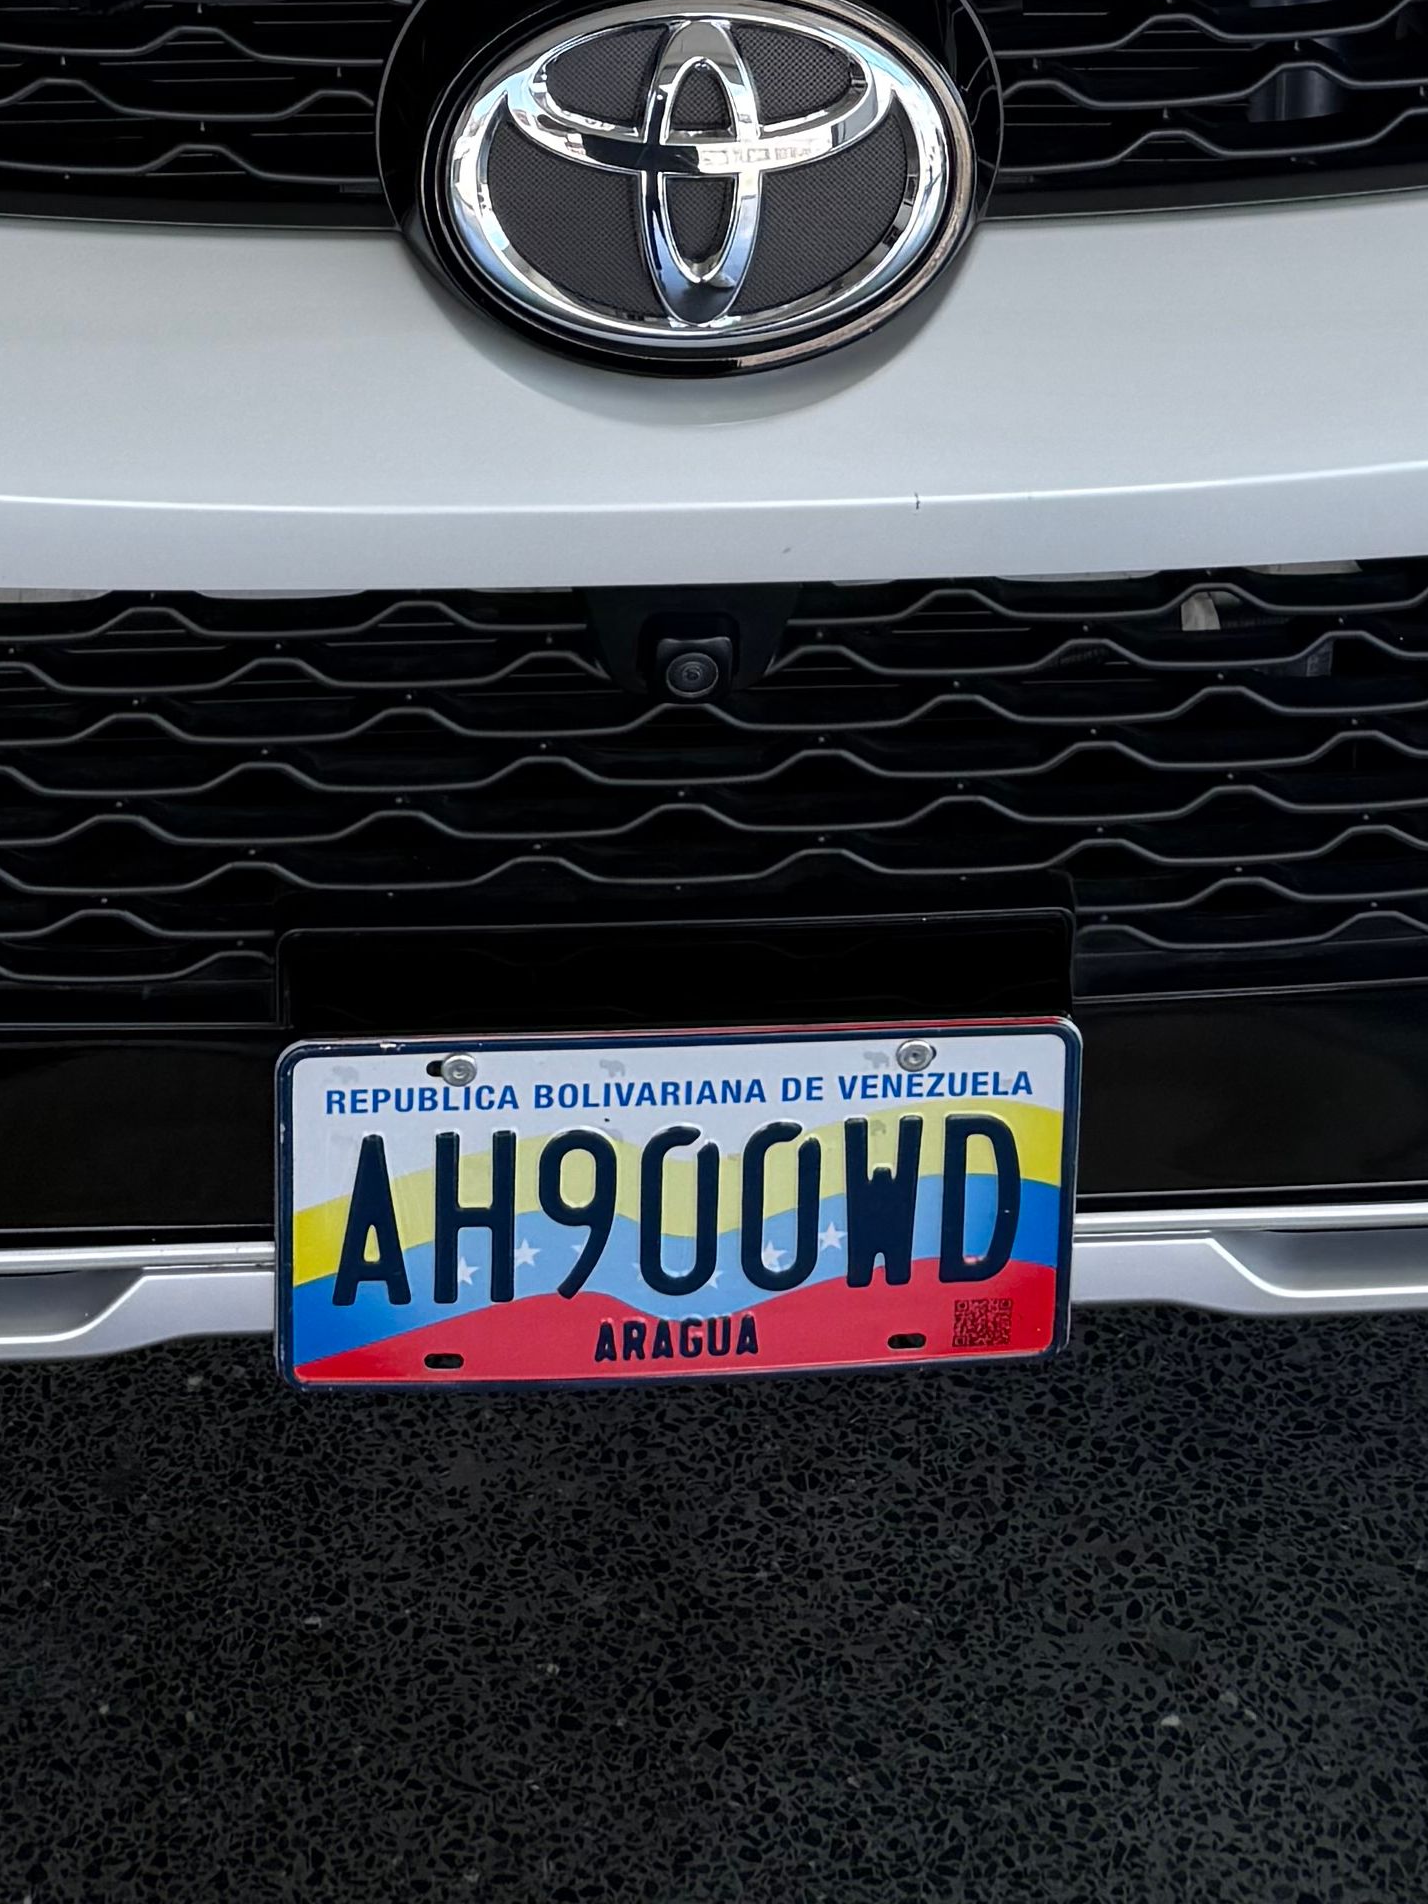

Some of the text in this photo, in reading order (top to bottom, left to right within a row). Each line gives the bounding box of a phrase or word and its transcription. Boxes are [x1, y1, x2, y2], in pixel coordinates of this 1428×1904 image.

[326, 1070, 1033, 1115] REPUBLICA BOLIVARIANA DE VENEZUELA
[330, 1115, 1023, 1308] AH900WD
[593, 1313, 760, 1364] ARAGUA
